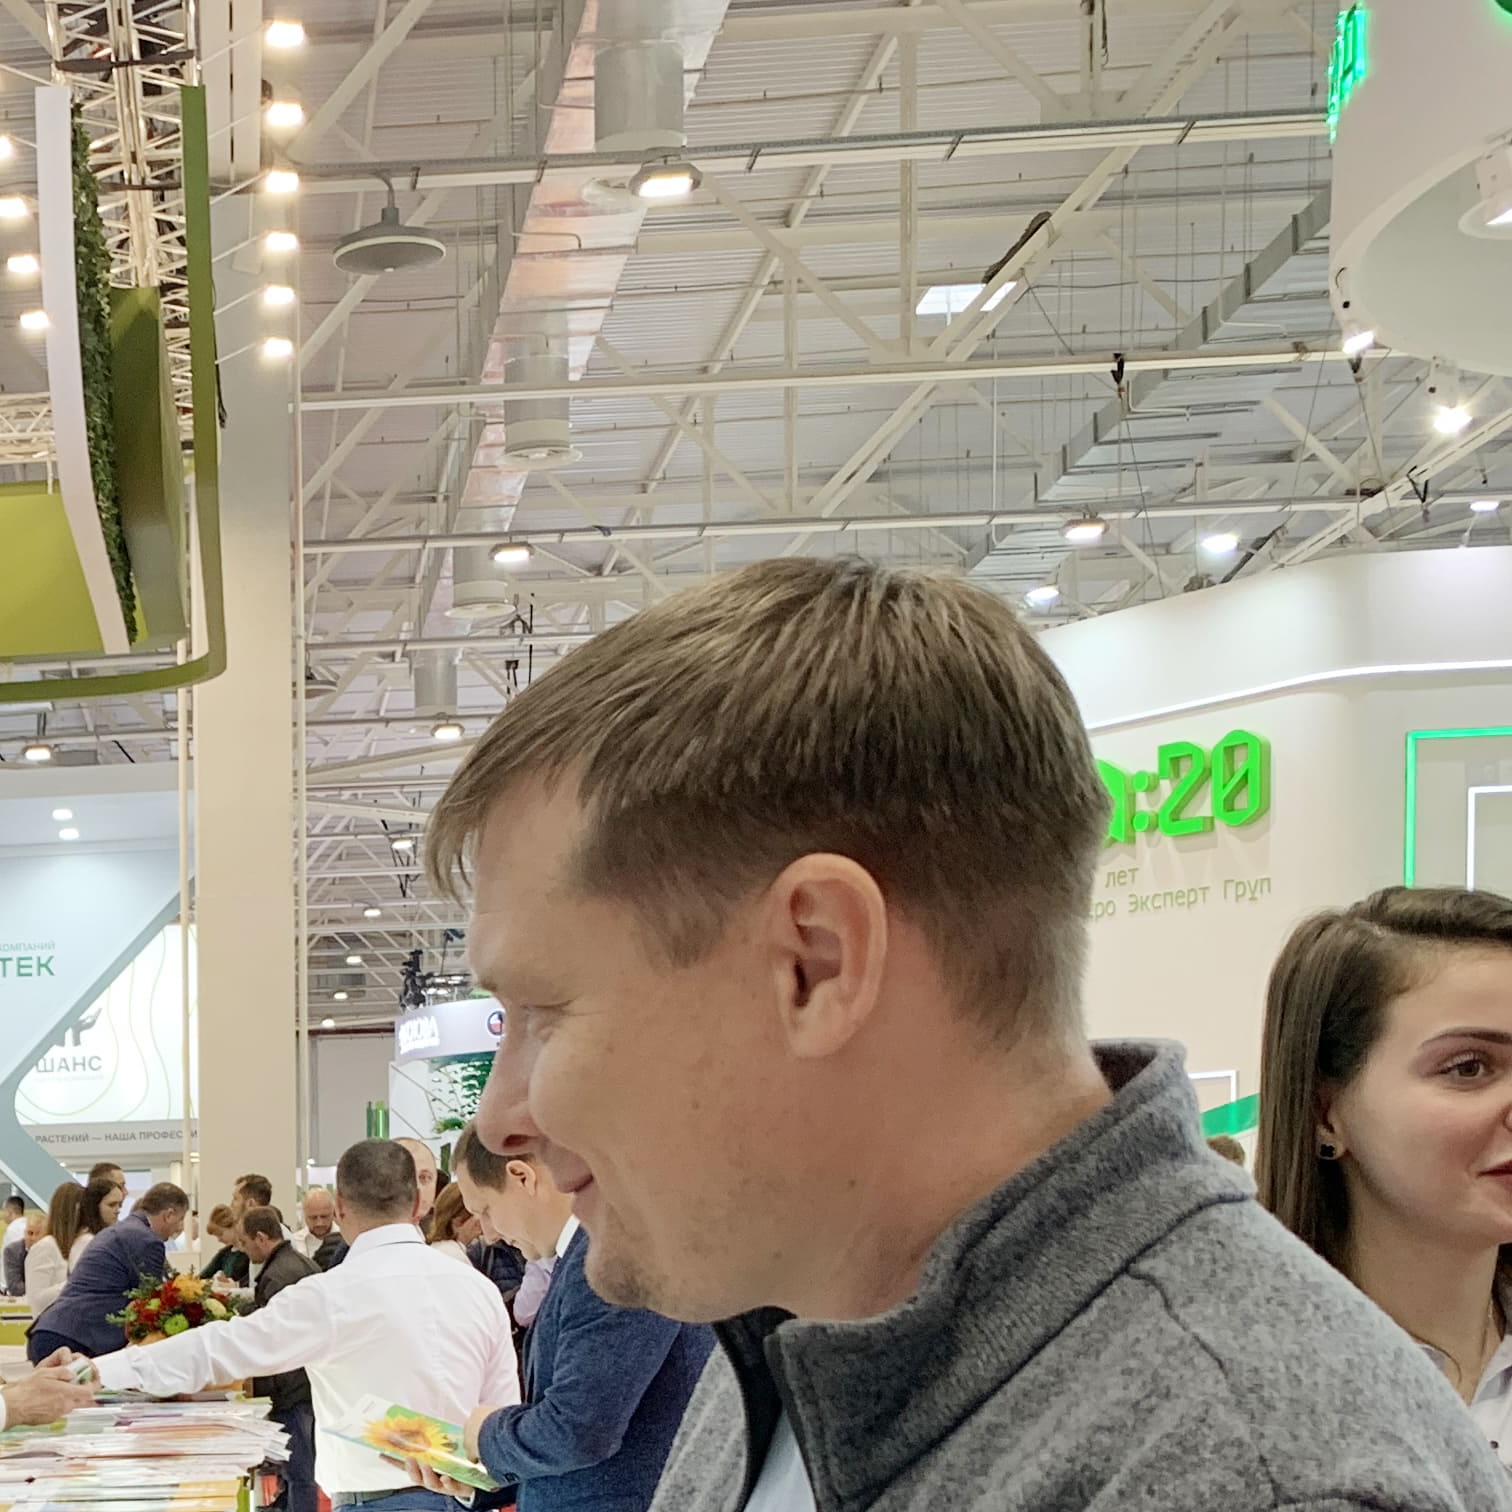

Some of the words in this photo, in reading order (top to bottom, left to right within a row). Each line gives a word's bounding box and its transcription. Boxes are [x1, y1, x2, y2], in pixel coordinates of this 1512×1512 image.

[1105, 868, 1139, 888] лет
[1128, 886, 1210, 914] Эксперт
[1223, 877, 1272, 904] Груп
[35, 1056, 102, 1073] ШАНС
[105, 1131, 137, 1142] НАША
